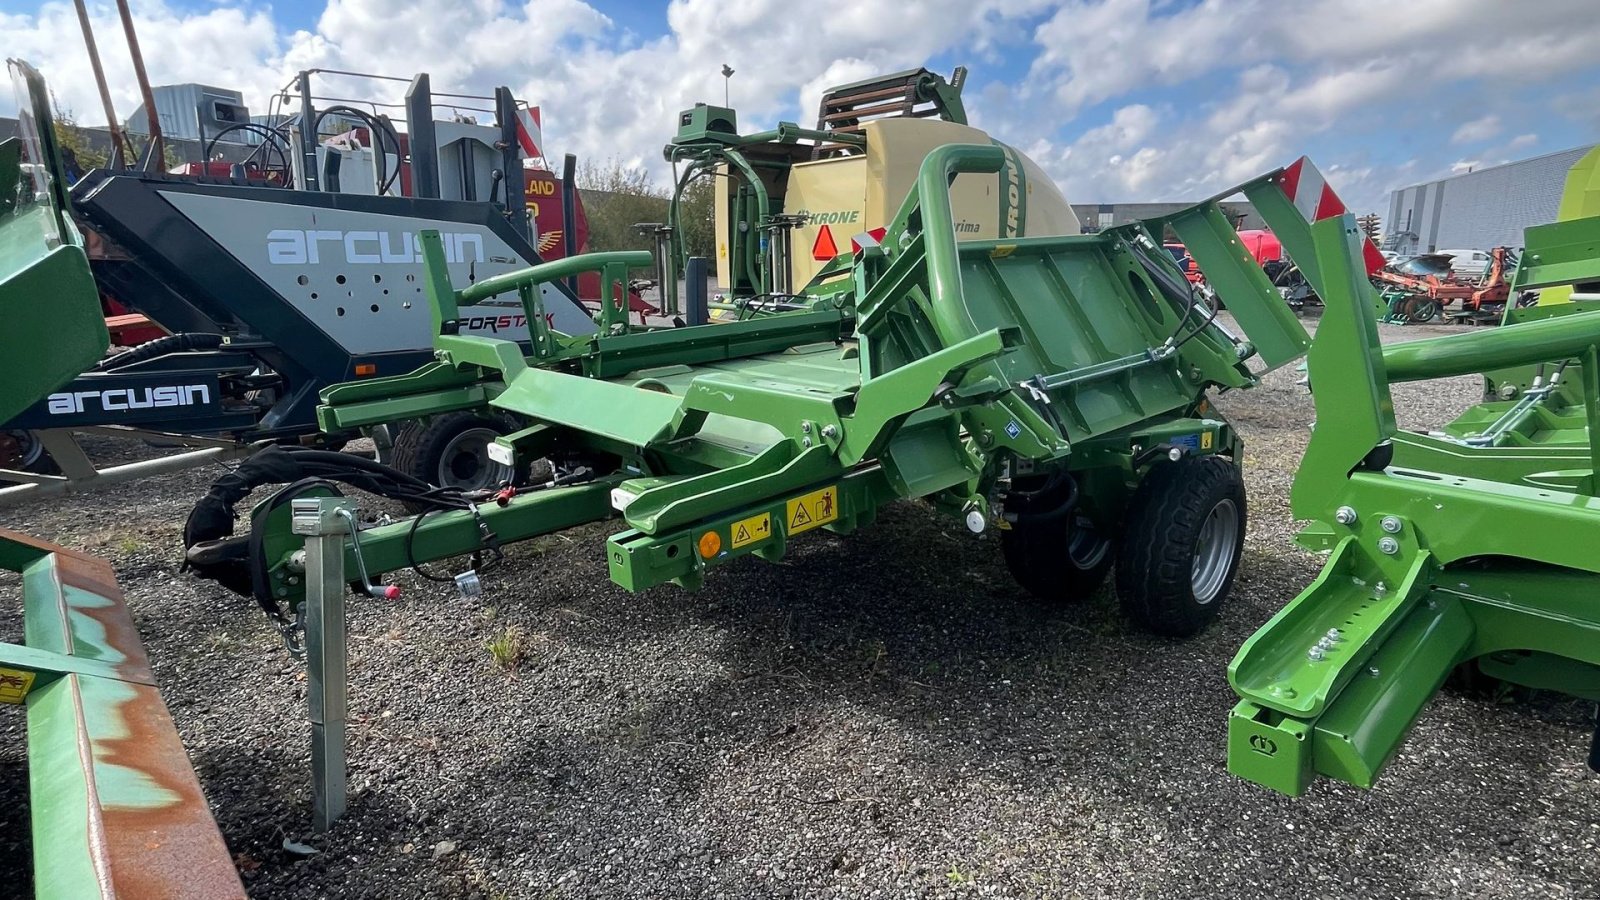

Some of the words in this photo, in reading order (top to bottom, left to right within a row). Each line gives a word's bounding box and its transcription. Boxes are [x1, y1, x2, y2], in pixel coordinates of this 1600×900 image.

[809, 211, 859, 225] KRONE
[954, 219, 980, 233] rima
[48, 384, 210, 415] arcusin
